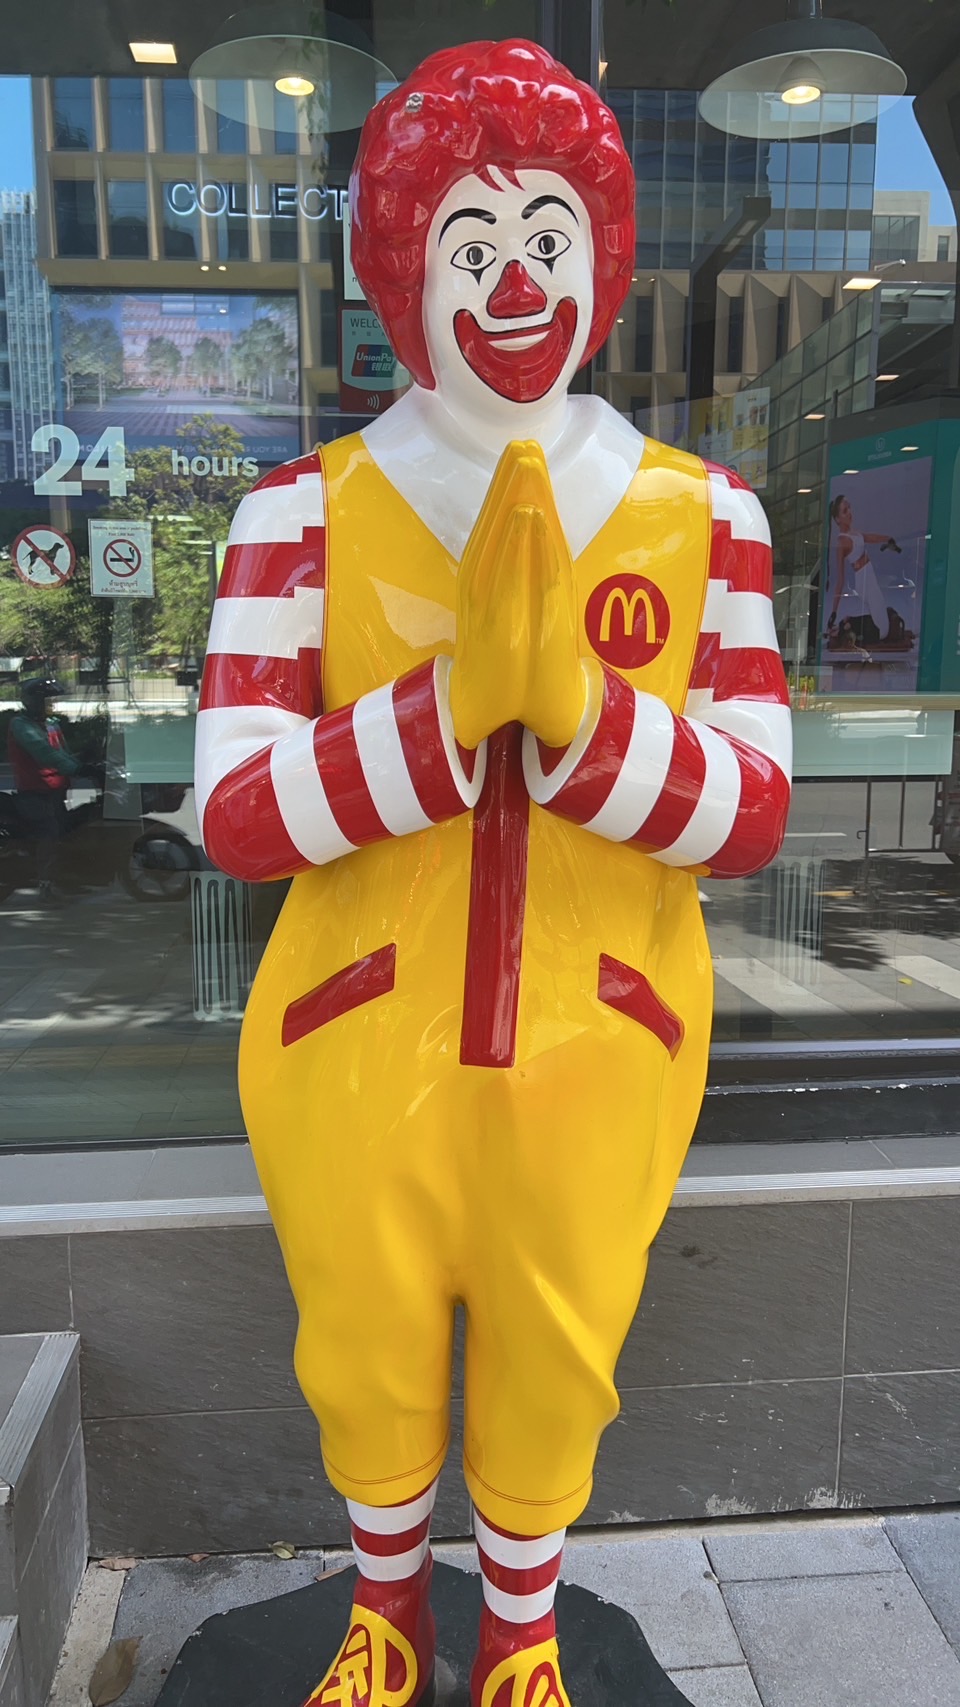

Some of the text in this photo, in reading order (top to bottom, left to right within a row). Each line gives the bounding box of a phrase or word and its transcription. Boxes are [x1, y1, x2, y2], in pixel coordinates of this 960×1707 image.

[167, 179, 349, 221] COLLECT
[350, 318, 383, 329] WELC
[31, 424, 259, 497] 24 hours
